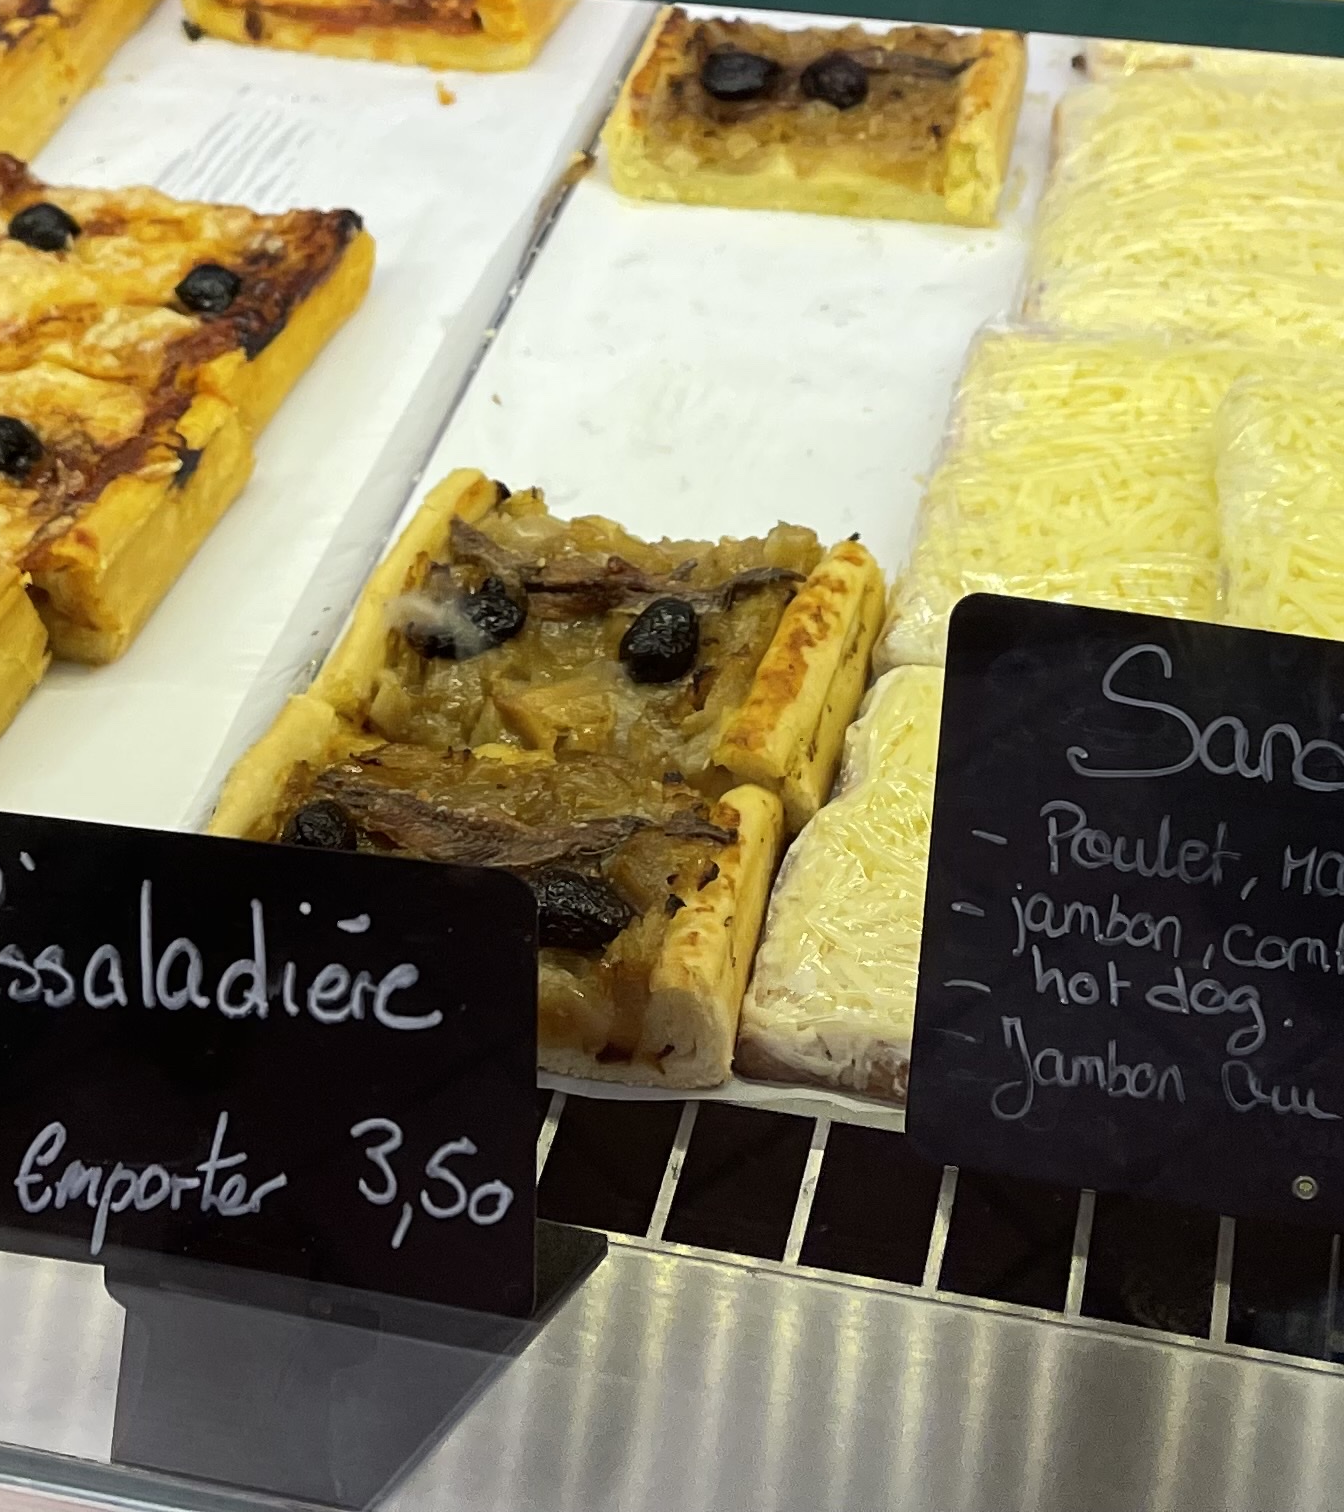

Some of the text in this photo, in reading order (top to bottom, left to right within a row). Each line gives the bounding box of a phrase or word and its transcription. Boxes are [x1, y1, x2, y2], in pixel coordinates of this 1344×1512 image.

[1032, 945, 1131, 1006] hot
[991, 1015, 1186, 1120] Jambon
[351, 1117, 514, 1248] 3,50
